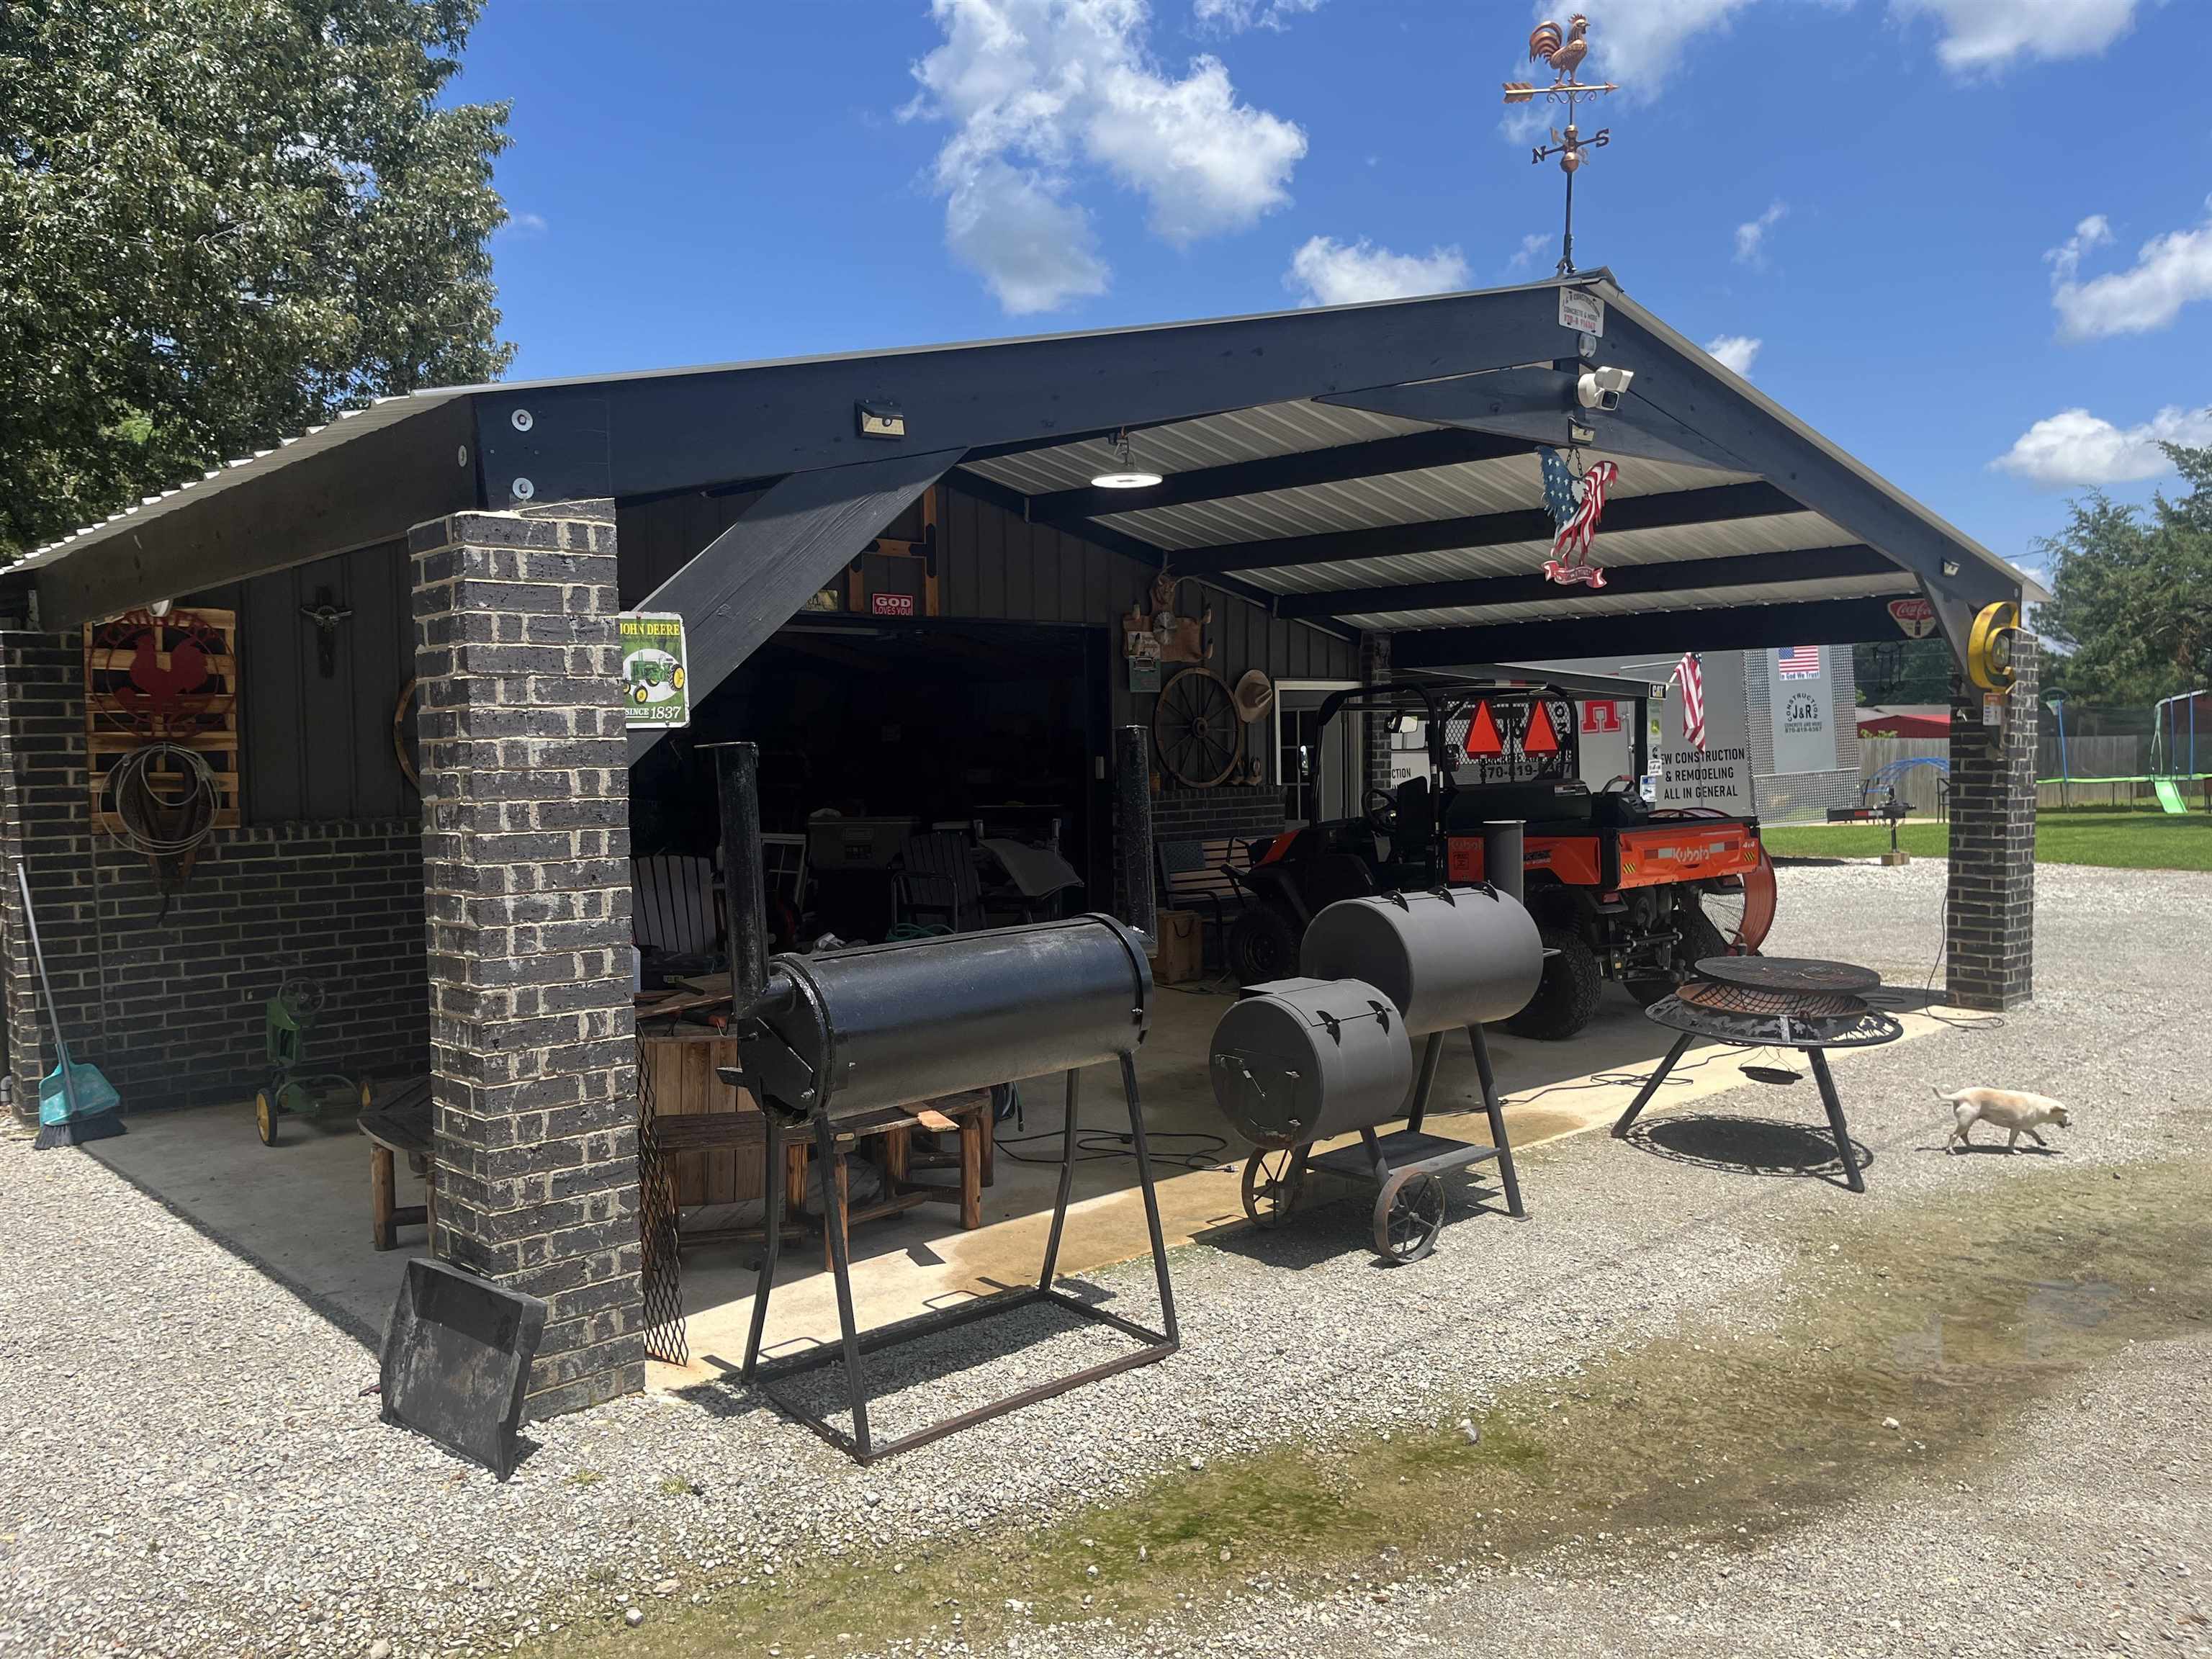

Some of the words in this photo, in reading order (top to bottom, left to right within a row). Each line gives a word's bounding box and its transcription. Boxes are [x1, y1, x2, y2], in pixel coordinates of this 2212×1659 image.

[1532, 145, 1546, 164] N
[876, 597, 911, 608] GOD
[875, 606, 896, 615] LOVES
[647, 623, 680, 636] DEERE
[1652, 685, 1664, 697] CAT
[649, 706, 681, 719] 1837
[1786, 692, 1818, 721] CONSTRUCTION
[1792, 704, 1812, 719] J&R
[1660, 753, 1672, 765] EW
[1675, 748, 1745, 764] CONSTRUCTION
[1665, 770, 1671, 782] &
[1675, 766, 1734, 781] REMODELING
[1664, 788, 1681, 800] ALL
[1683, 787, 1691, 799] IN
[1695, 785, 1738, 798] GENERAL
[1673, 845, 1709, 863] Kubota
